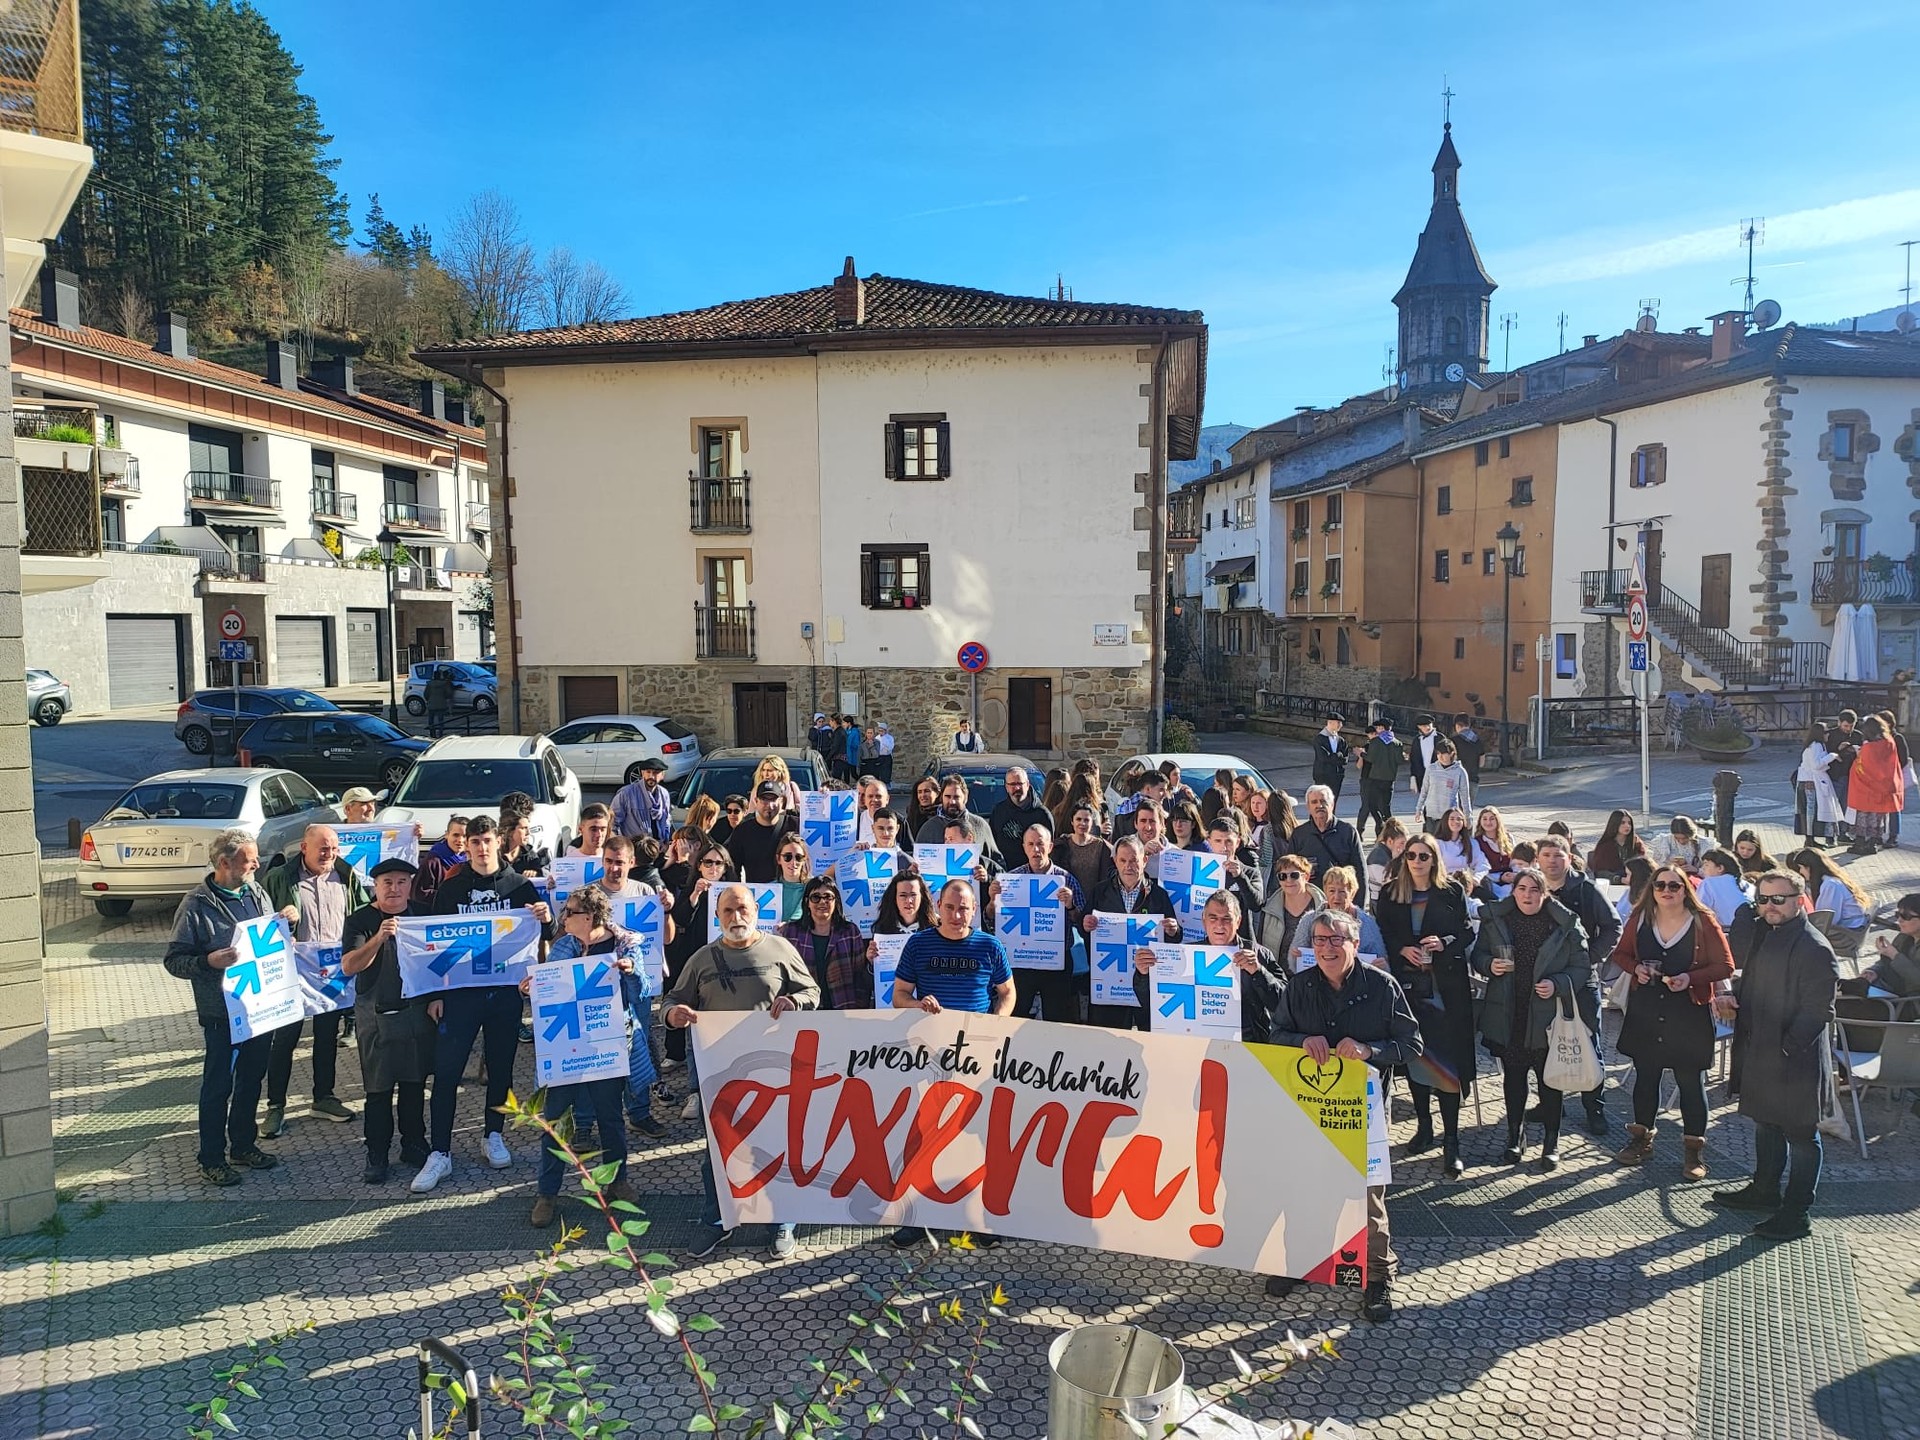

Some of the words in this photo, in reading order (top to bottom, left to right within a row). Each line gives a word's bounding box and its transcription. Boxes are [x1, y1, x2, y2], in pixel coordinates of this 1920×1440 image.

[1632, 611, 1641, 625] 20
[225, 620, 240, 630] 20
[131, 847, 158, 856] 7742
[160, 846, 180, 856] CRF
[431, 924, 487, 939] etxera
[1202, 990, 1230, 1000] Etxera
[584, 1003, 612, 1012] Etxera
[1202, 999, 1226, 1007] bidea
[584, 1012, 610, 1022] bidea
[1202, 1007, 1226, 1016] gertu
[585, 1022, 609, 1032] gertu
[561, 1054, 600, 1066] Autonomia
[600, 1050, 619, 1059] kalea
[562, 1061, 596, 1072] betetzera
[596, 1058, 614, 1068] goaz!
[847, 1044, 930, 1078] preso
[940, 1030, 980, 1075] eta
[993, 1036, 1140, 1100] iheslariak
[1298, 1094, 1322, 1104] Preso
[1324, 1096, 1363, 1106] gaixoak
[1320, 1106, 1348, 1118] aske
[1350, 1108, 1362, 1117] ta
[1320, 1117, 1362, 1130] bizirik!
[709, 1028, 1229, 1248] etxera!
